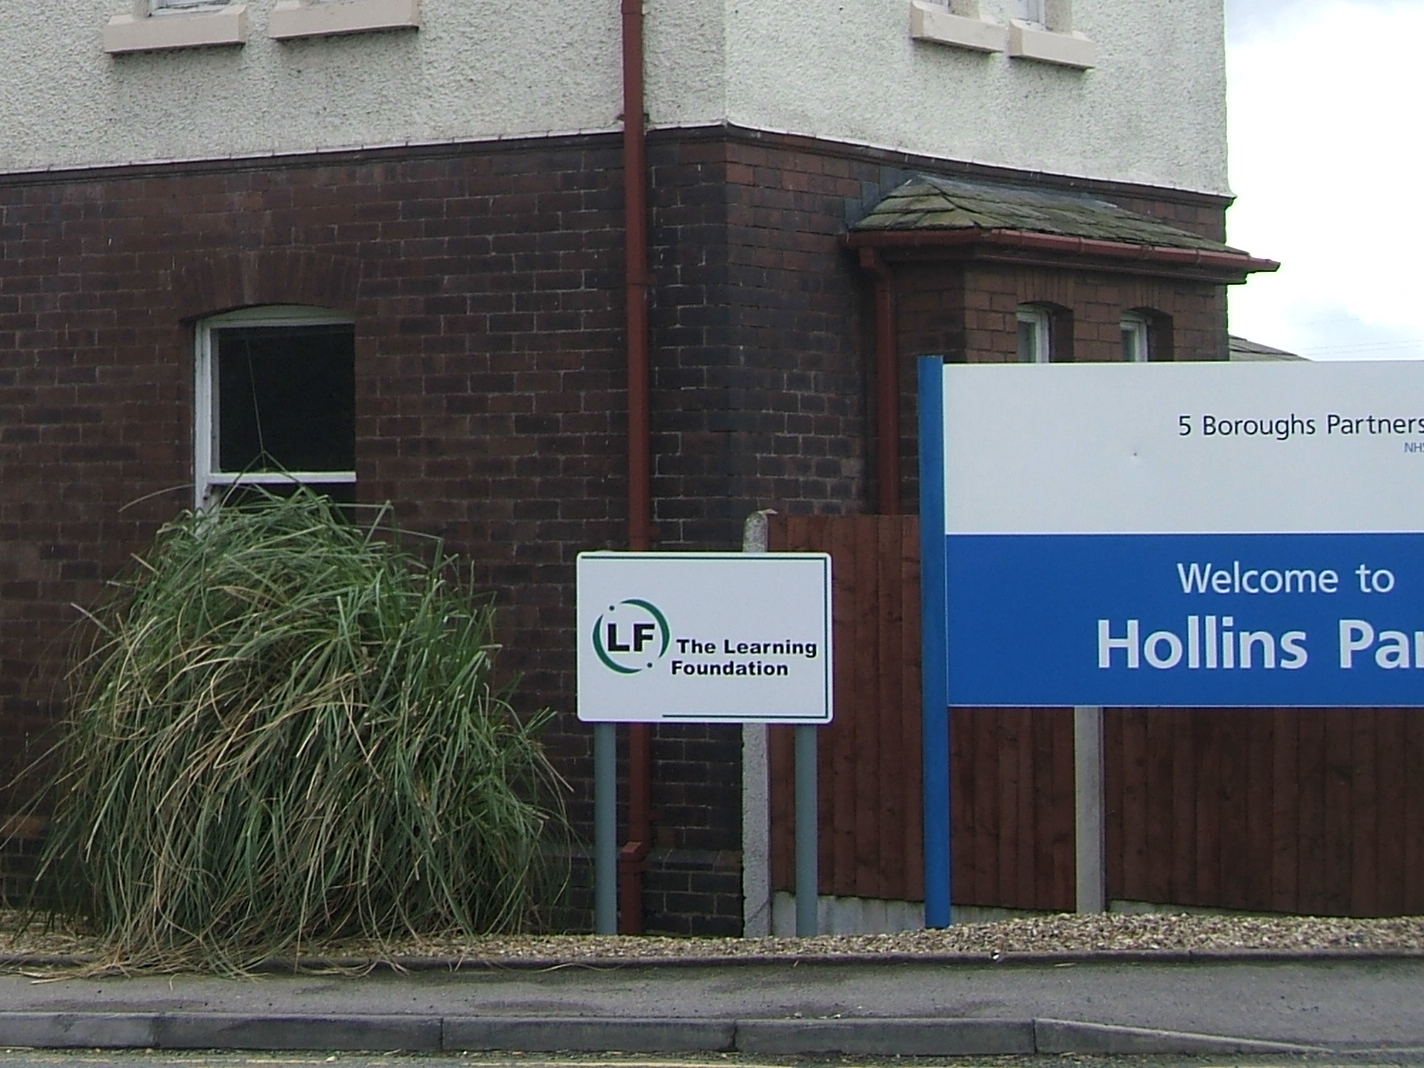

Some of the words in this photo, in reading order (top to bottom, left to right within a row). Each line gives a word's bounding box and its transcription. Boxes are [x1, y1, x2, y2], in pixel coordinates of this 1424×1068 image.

[1178, 416, 1192, 437] 5
[1202, 414, 1316, 440] Boroughs
[1404, 442, 1424, 453] NH
[1177, 561, 1339, 594] Welcome
[1355, 564, 1395, 594] to
[607, 623, 655, 653] LF
[676, 639, 717, 654] The
[724, 639, 817, 658] Learning
[1098, 615, 1308, 669] Hollins
[671, 660, 788, 676] Foundation
